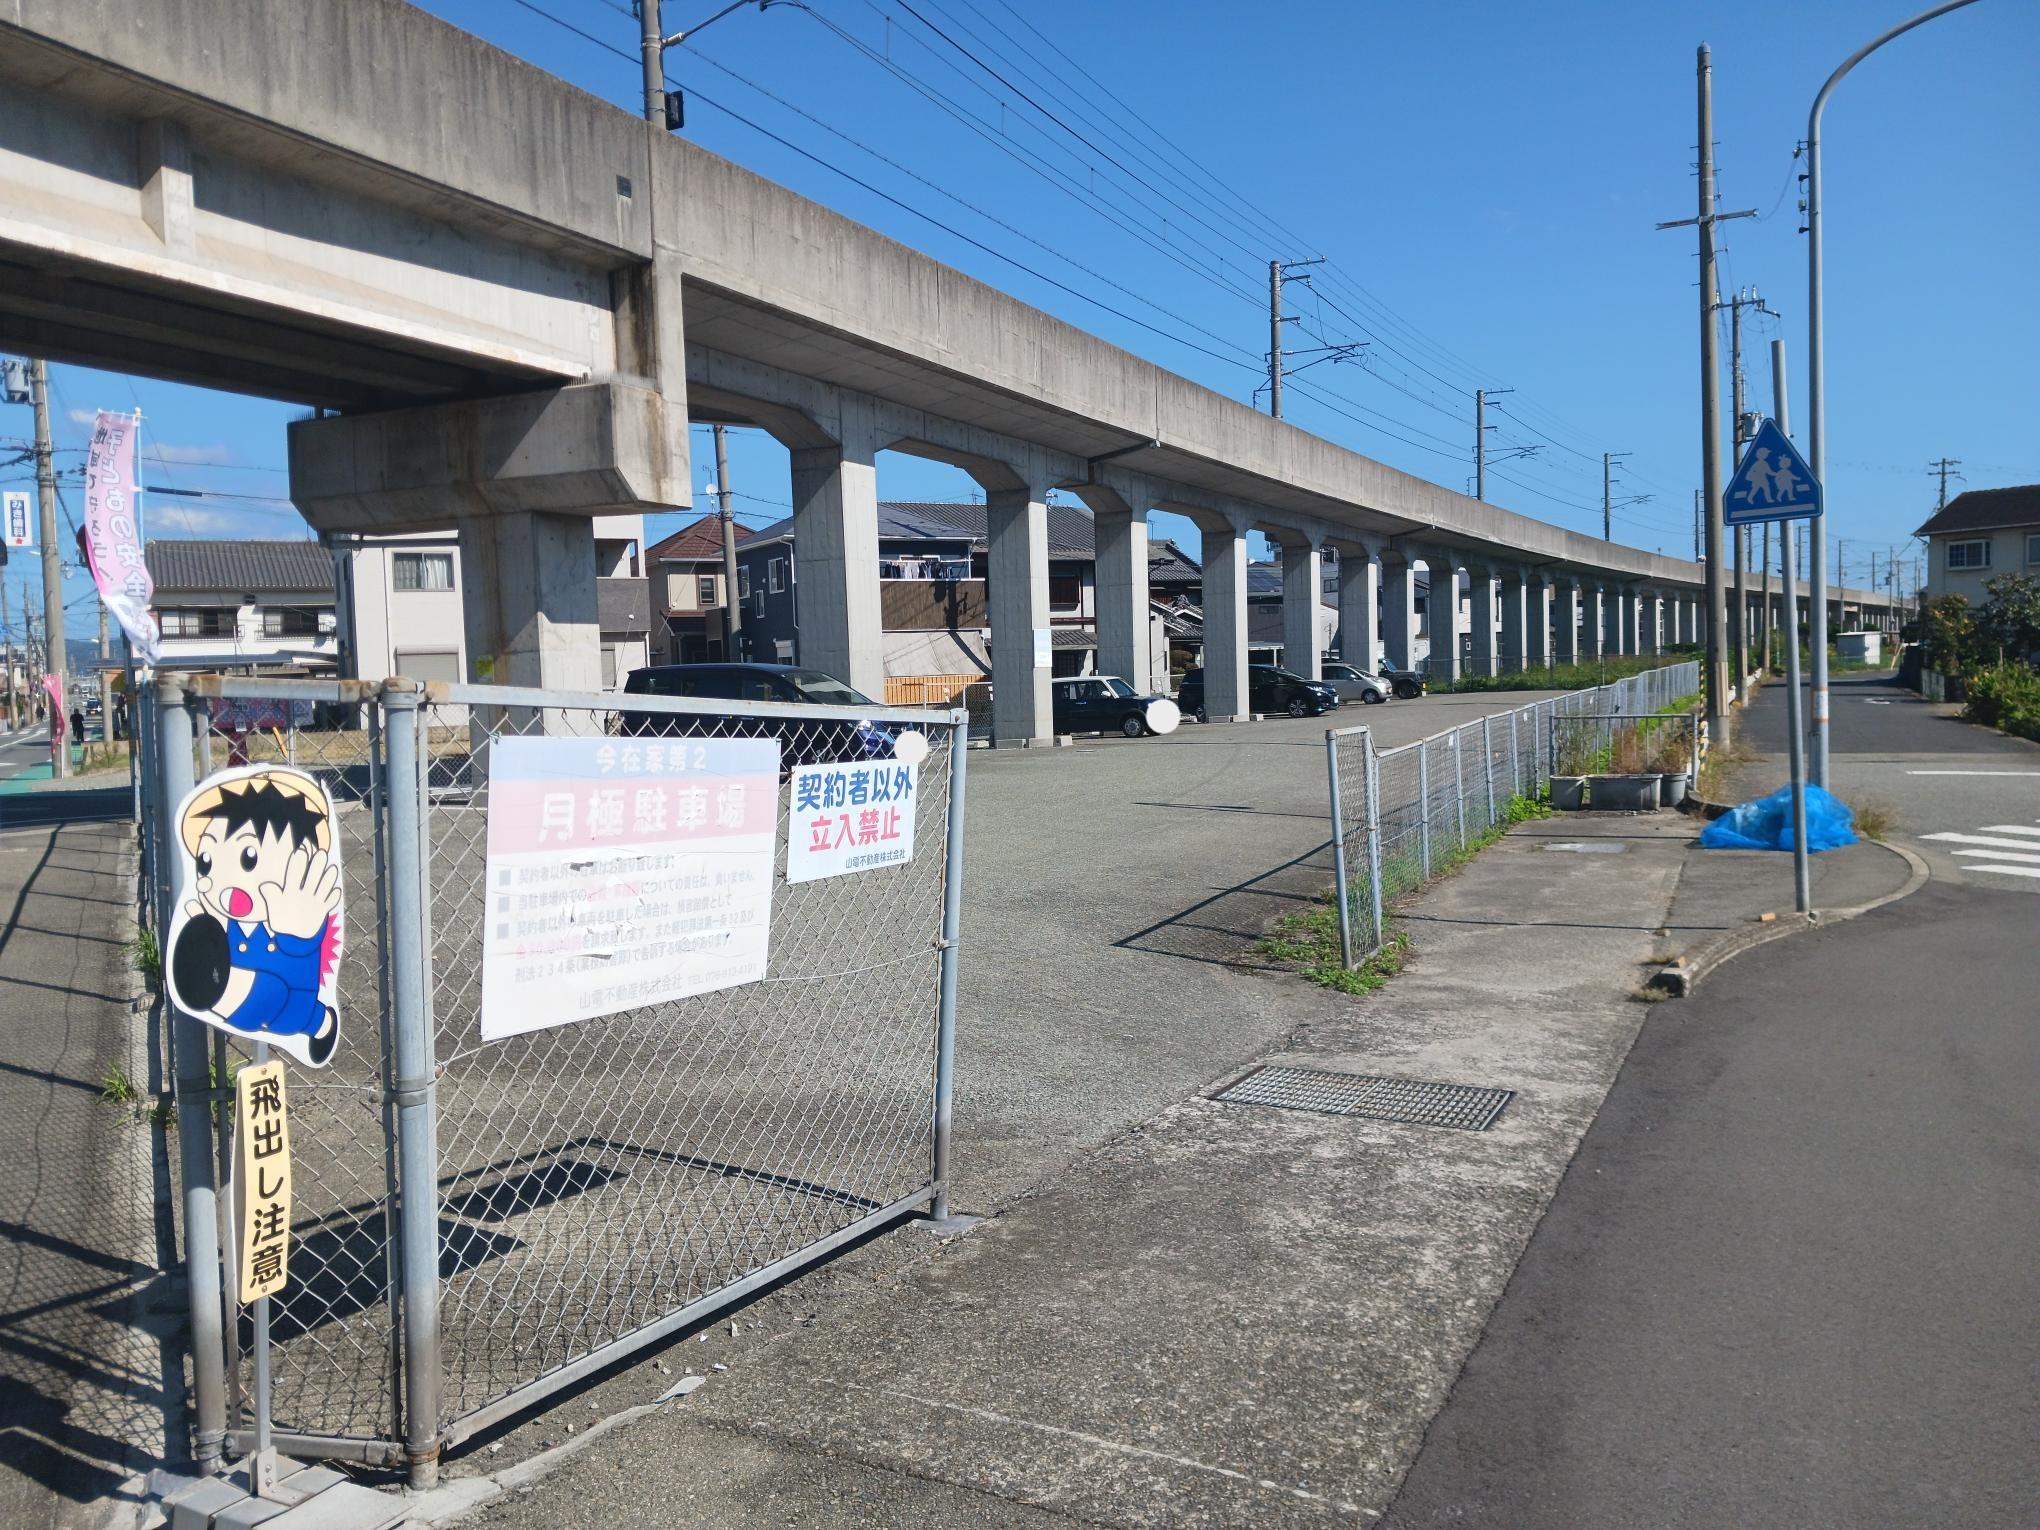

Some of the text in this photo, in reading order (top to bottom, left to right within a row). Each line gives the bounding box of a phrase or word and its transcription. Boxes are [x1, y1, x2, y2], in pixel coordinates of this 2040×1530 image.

[796, 765, 913, 813] 契約者以外
[537, 784, 746, 843] 月極駐車場
[808, 805, 901, 852] 立入禁止
[845, 848, 906, 869] 山電不動産株式会社
[579, 973, 682, 1010] 山電不動産株式会社
[249, 1076, 286, 1290] 飛出し注意
